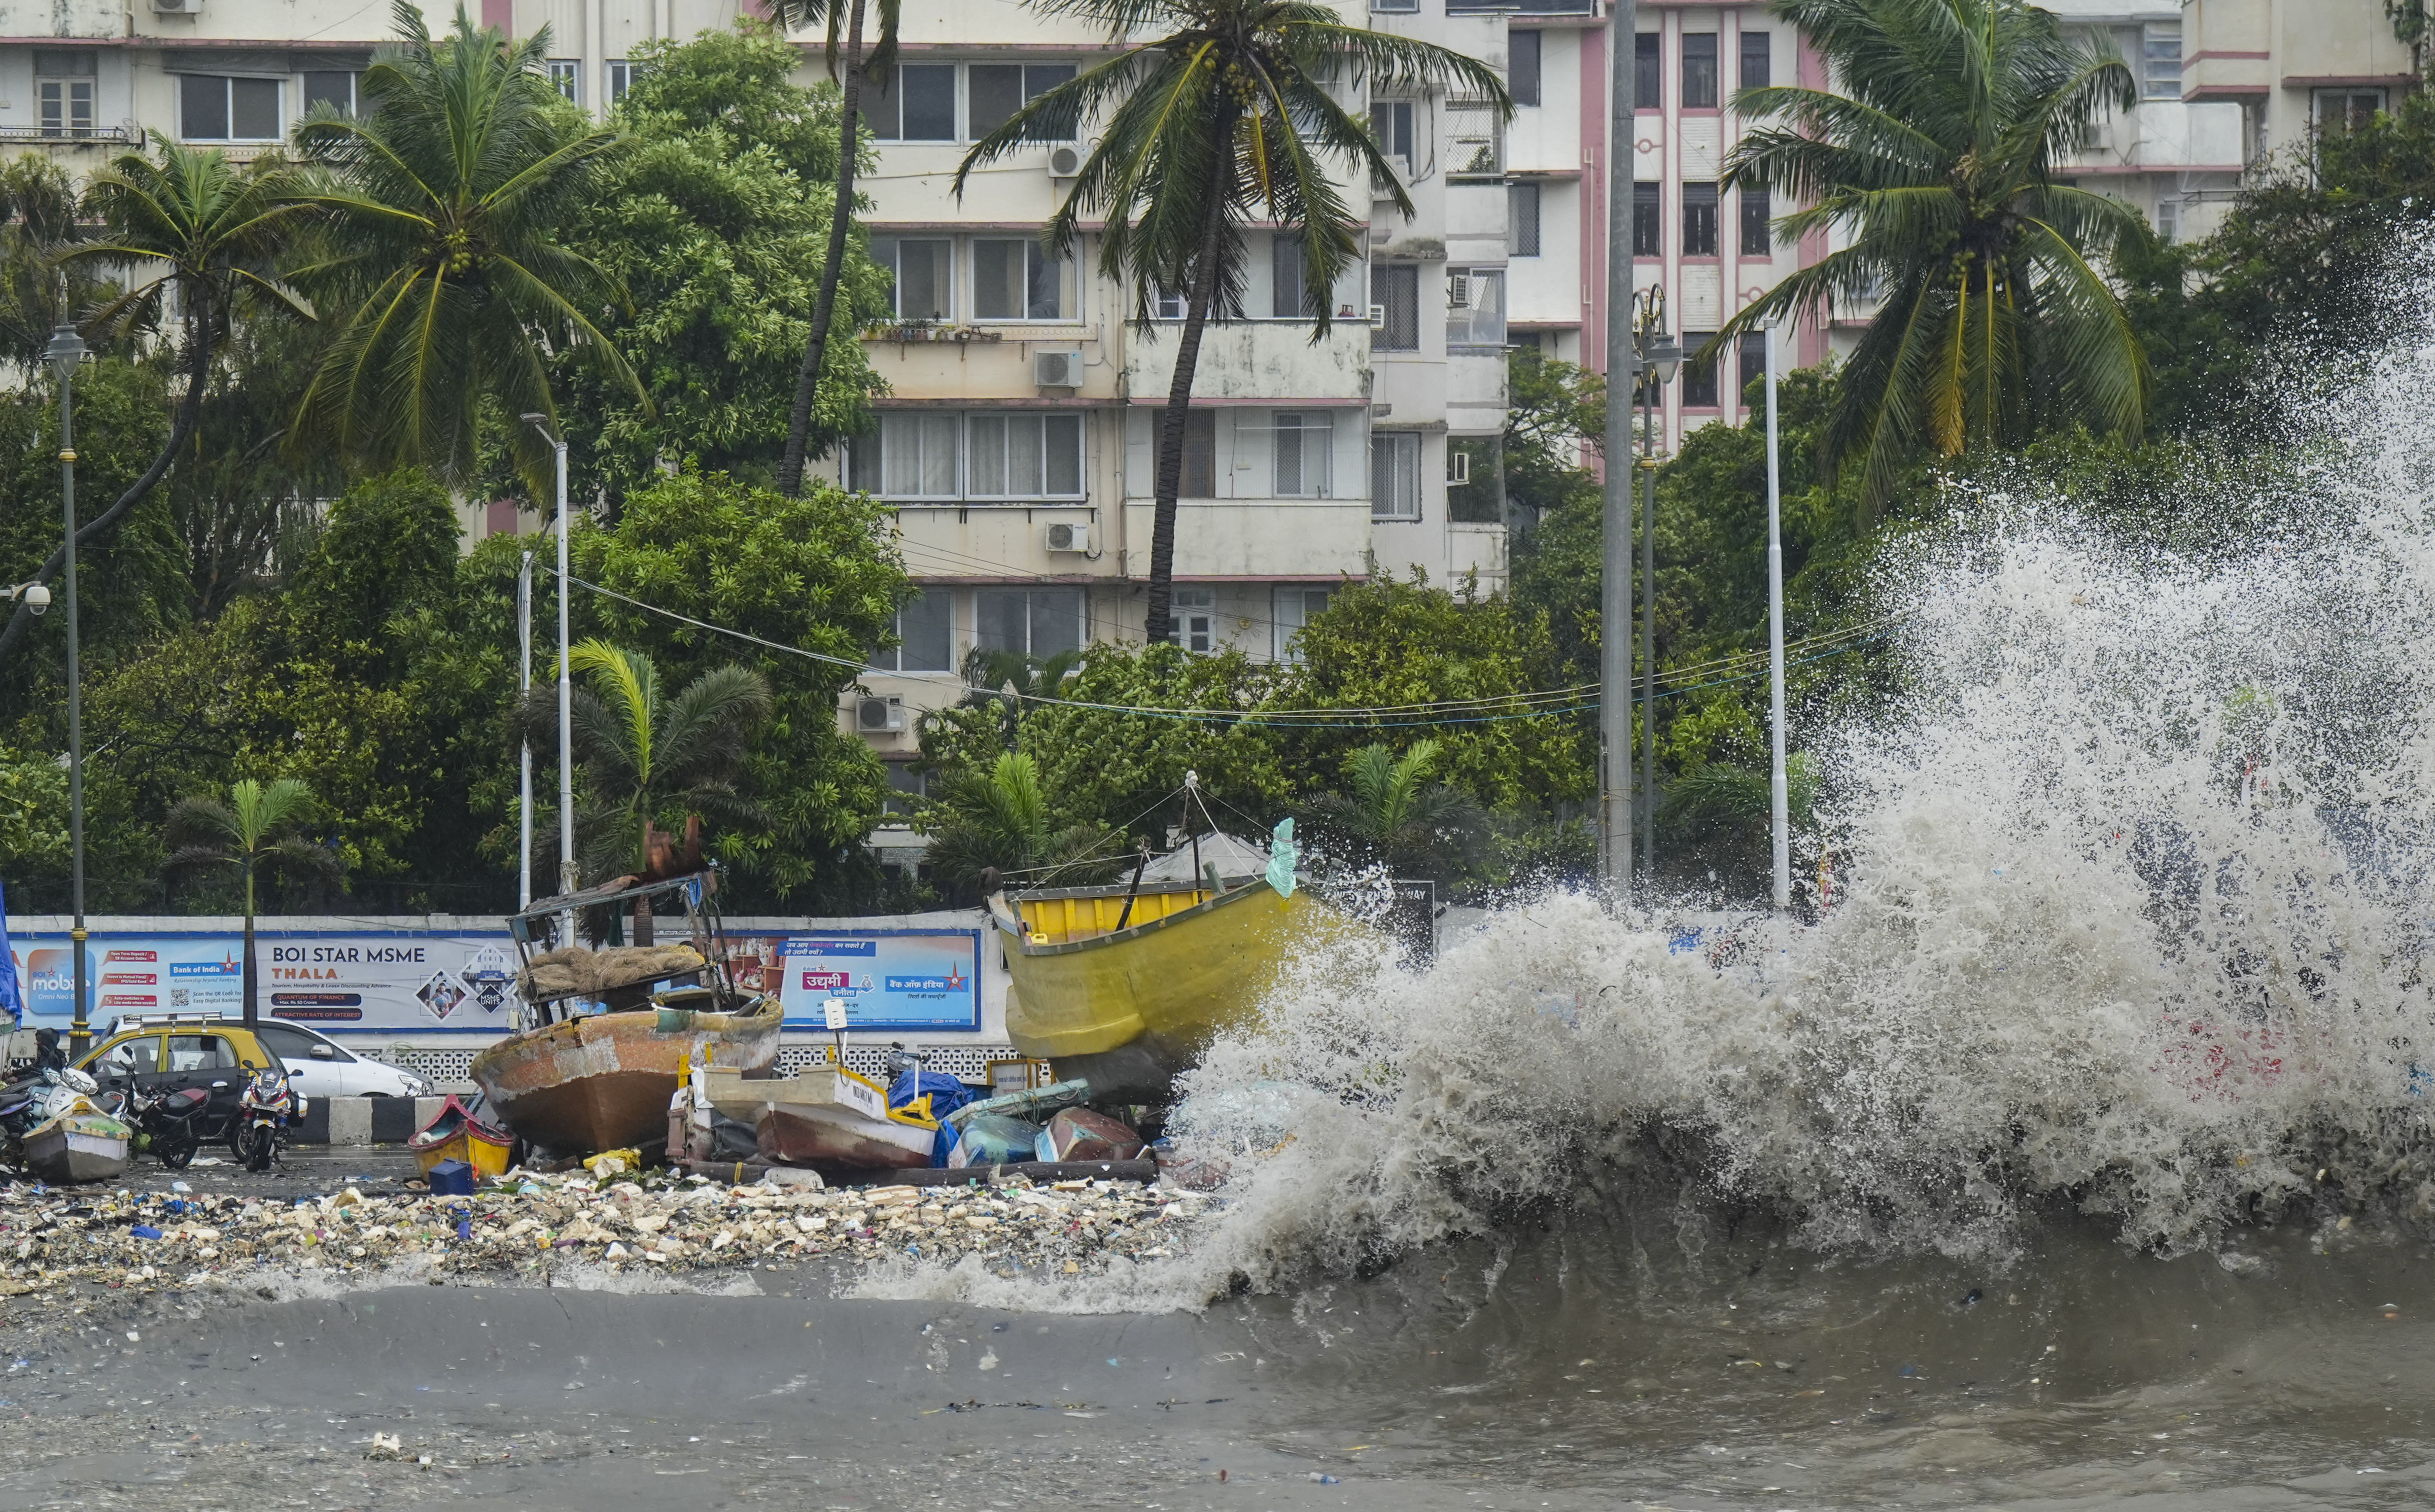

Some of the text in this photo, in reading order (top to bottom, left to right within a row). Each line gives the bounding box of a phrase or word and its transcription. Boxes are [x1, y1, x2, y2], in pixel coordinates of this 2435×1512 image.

[273, 947, 425, 962] BOI STAR MSME
[271, 968, 338, 979] THALA
[807, 973, 842, 989] उद्यमी
[890, 980, 902, 988] बैंक
[923, 980, 944, 989] इंडिया
[833, 988, 855, 996] वनीता
